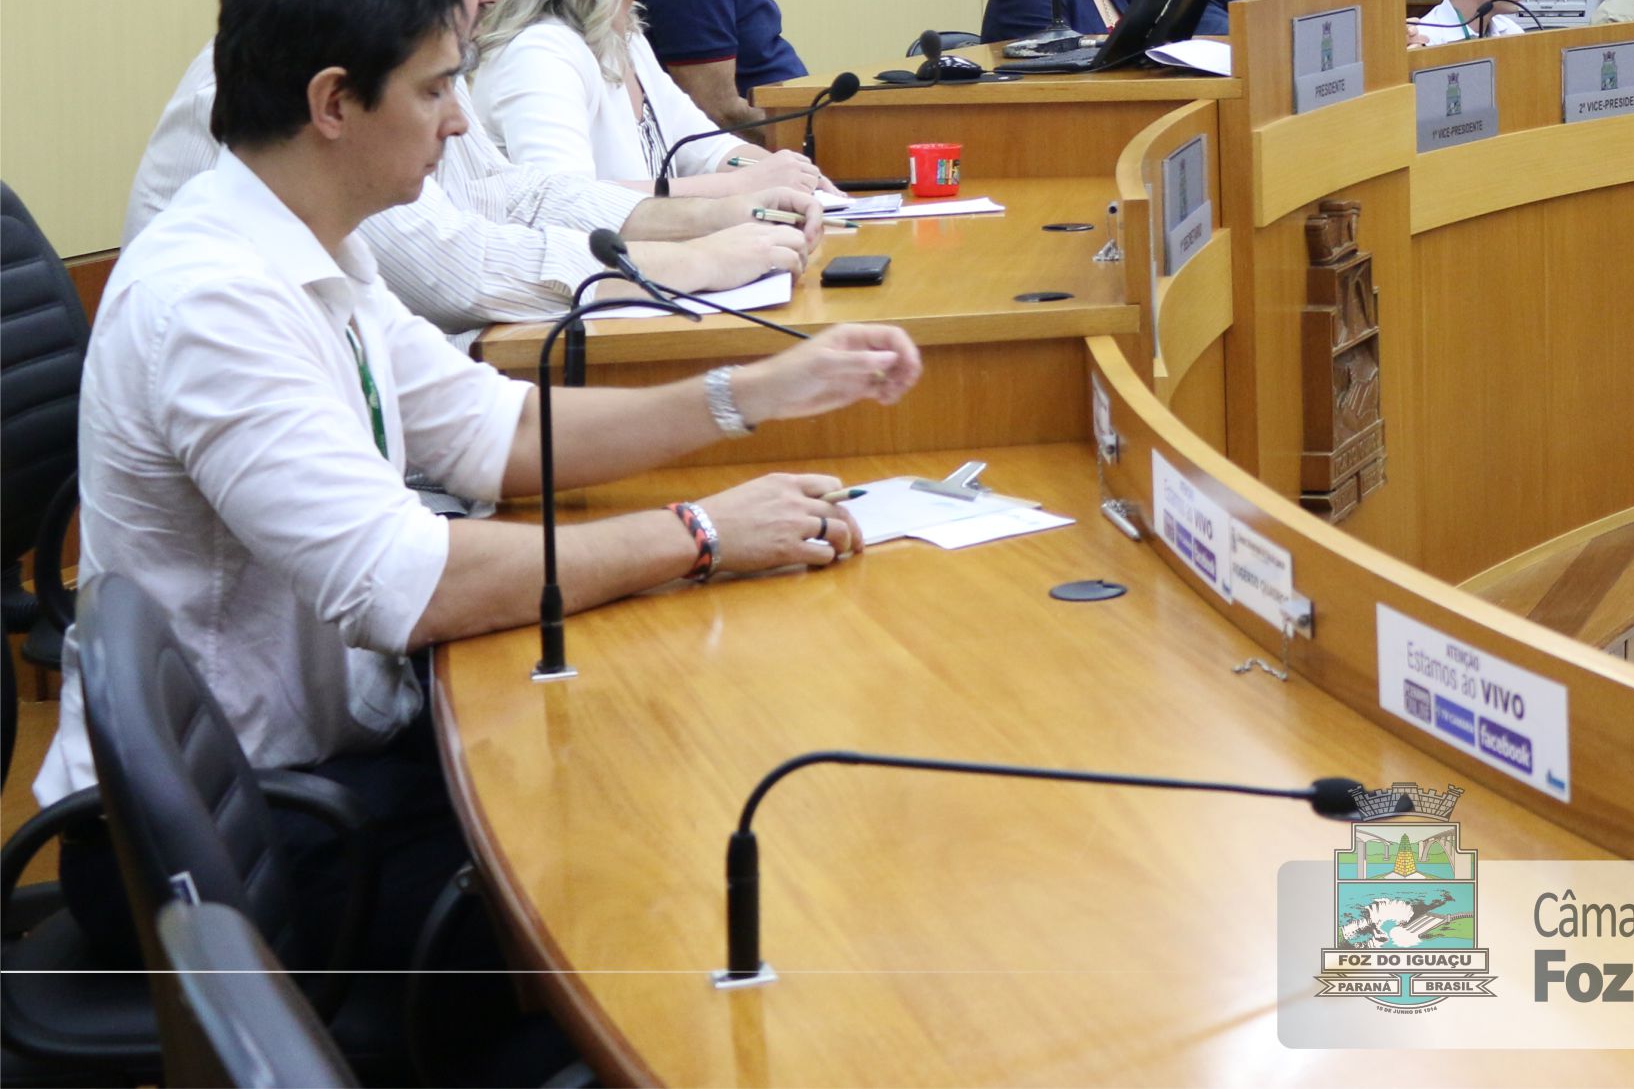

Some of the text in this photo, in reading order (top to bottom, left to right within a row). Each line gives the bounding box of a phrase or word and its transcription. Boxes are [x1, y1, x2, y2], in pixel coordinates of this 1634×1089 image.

[1314, 78, 1345, 99] PRESIDENTE
[1438, 120, 1483, 139] VICE-PRESIDENTE
[1446, 643, 1480, 672] ATENÇÃO
[1407, 639, 1457, 691] Estamos
[1461, 673, 1477, 700] ao
[1481, 678, 1525, 721] VIVO
[1480, 723, 1530, 767] facebook
